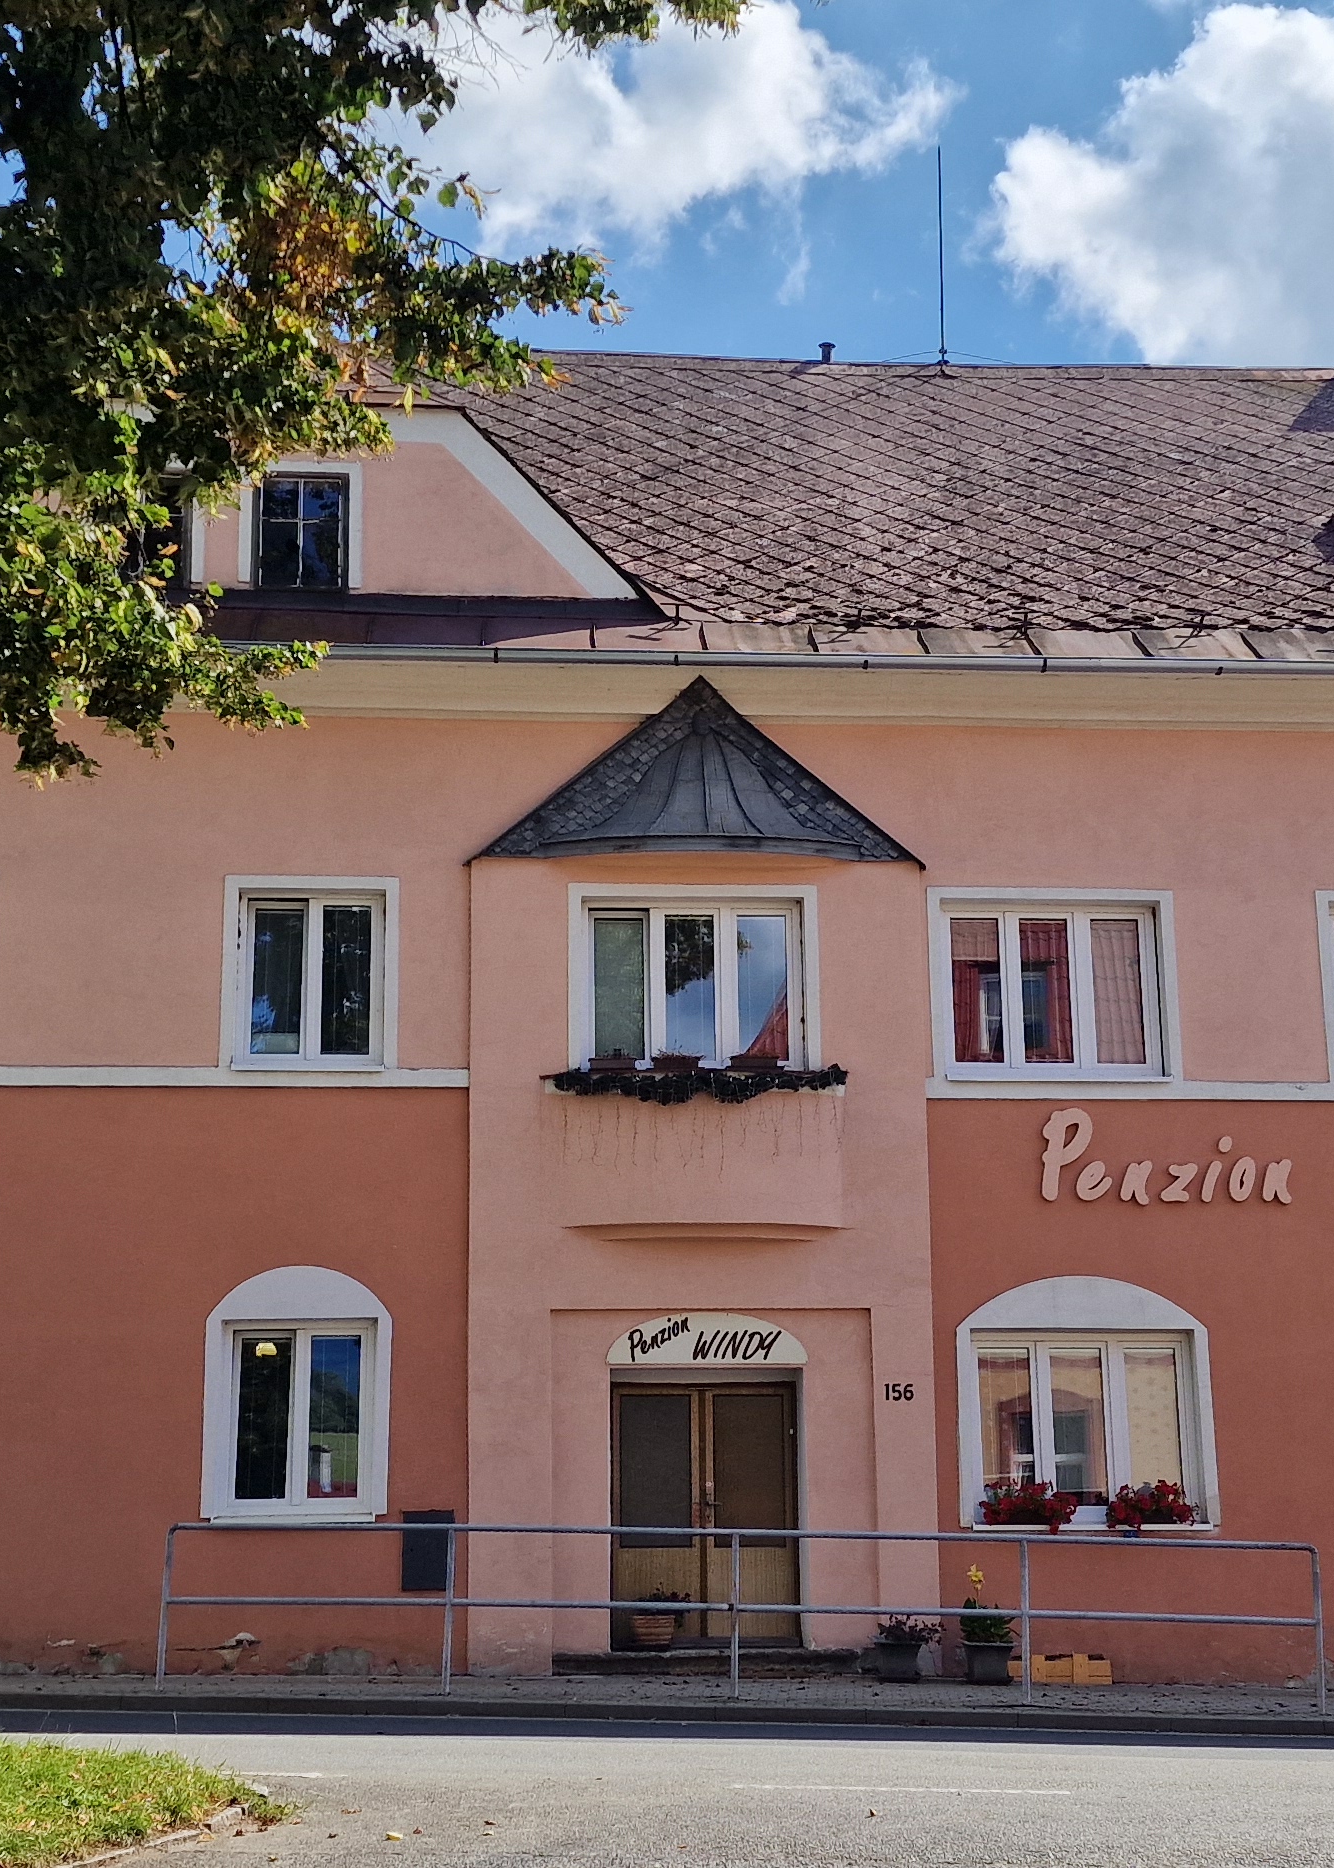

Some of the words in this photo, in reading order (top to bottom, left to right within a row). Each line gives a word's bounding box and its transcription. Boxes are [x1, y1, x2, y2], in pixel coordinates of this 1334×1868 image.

[1042, 1108, 1292, 1204] Penzion
[628, 1316, 690, 1361] Penzion
[692, 1330, 782, 1360] WINDY
[884, 1383, 914, 1401] 156
